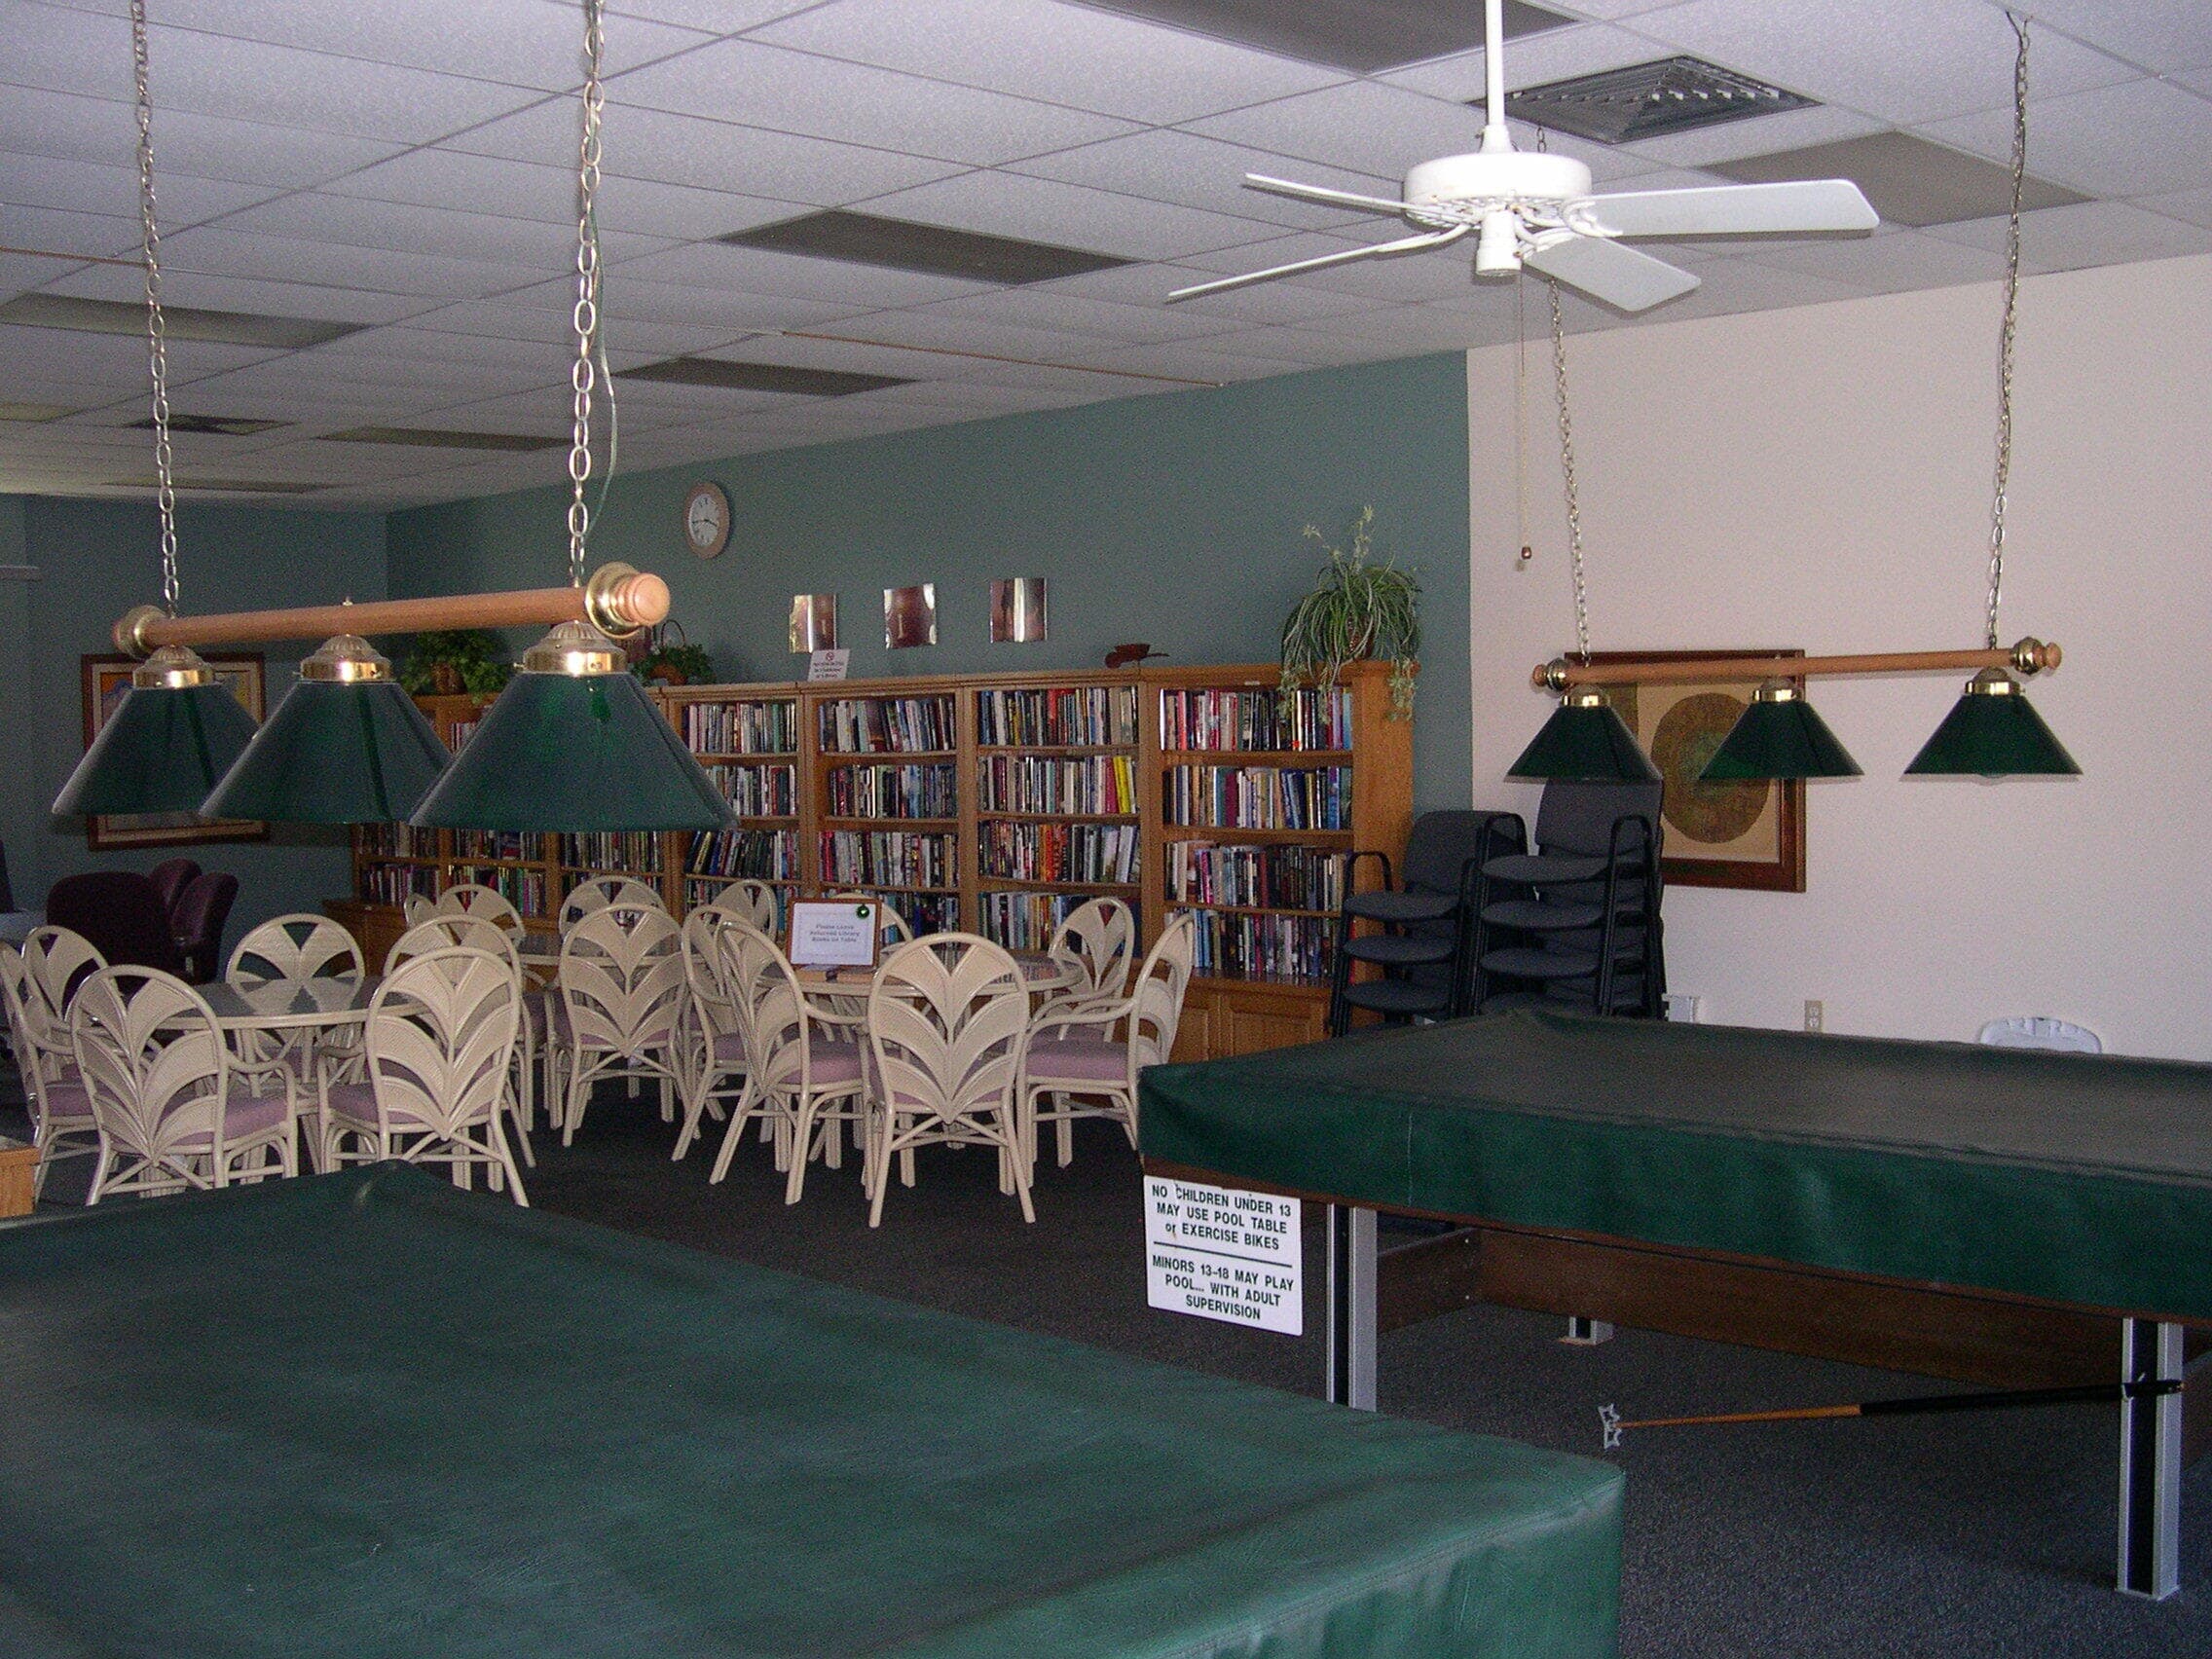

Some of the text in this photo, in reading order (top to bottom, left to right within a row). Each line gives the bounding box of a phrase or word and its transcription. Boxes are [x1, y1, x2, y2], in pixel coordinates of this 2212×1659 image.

[1152, 1185, 1291, 1217] NO CHILDREN UNDER 13
[1157, 1202, 1287, 1234] MAY USE POOL TABLE
[1165, 1223, 1279, 1250] or EXERCISE BIKES
[1152, 1255, 1294, 1291] MINORS 13-18 MAY PLAY
[1186, 1294, 1261, 1320] SUPERVISION
[1210, 1282, 1239, 1299] WITH
[1245, 1289, 1281, 1307] ADULT
